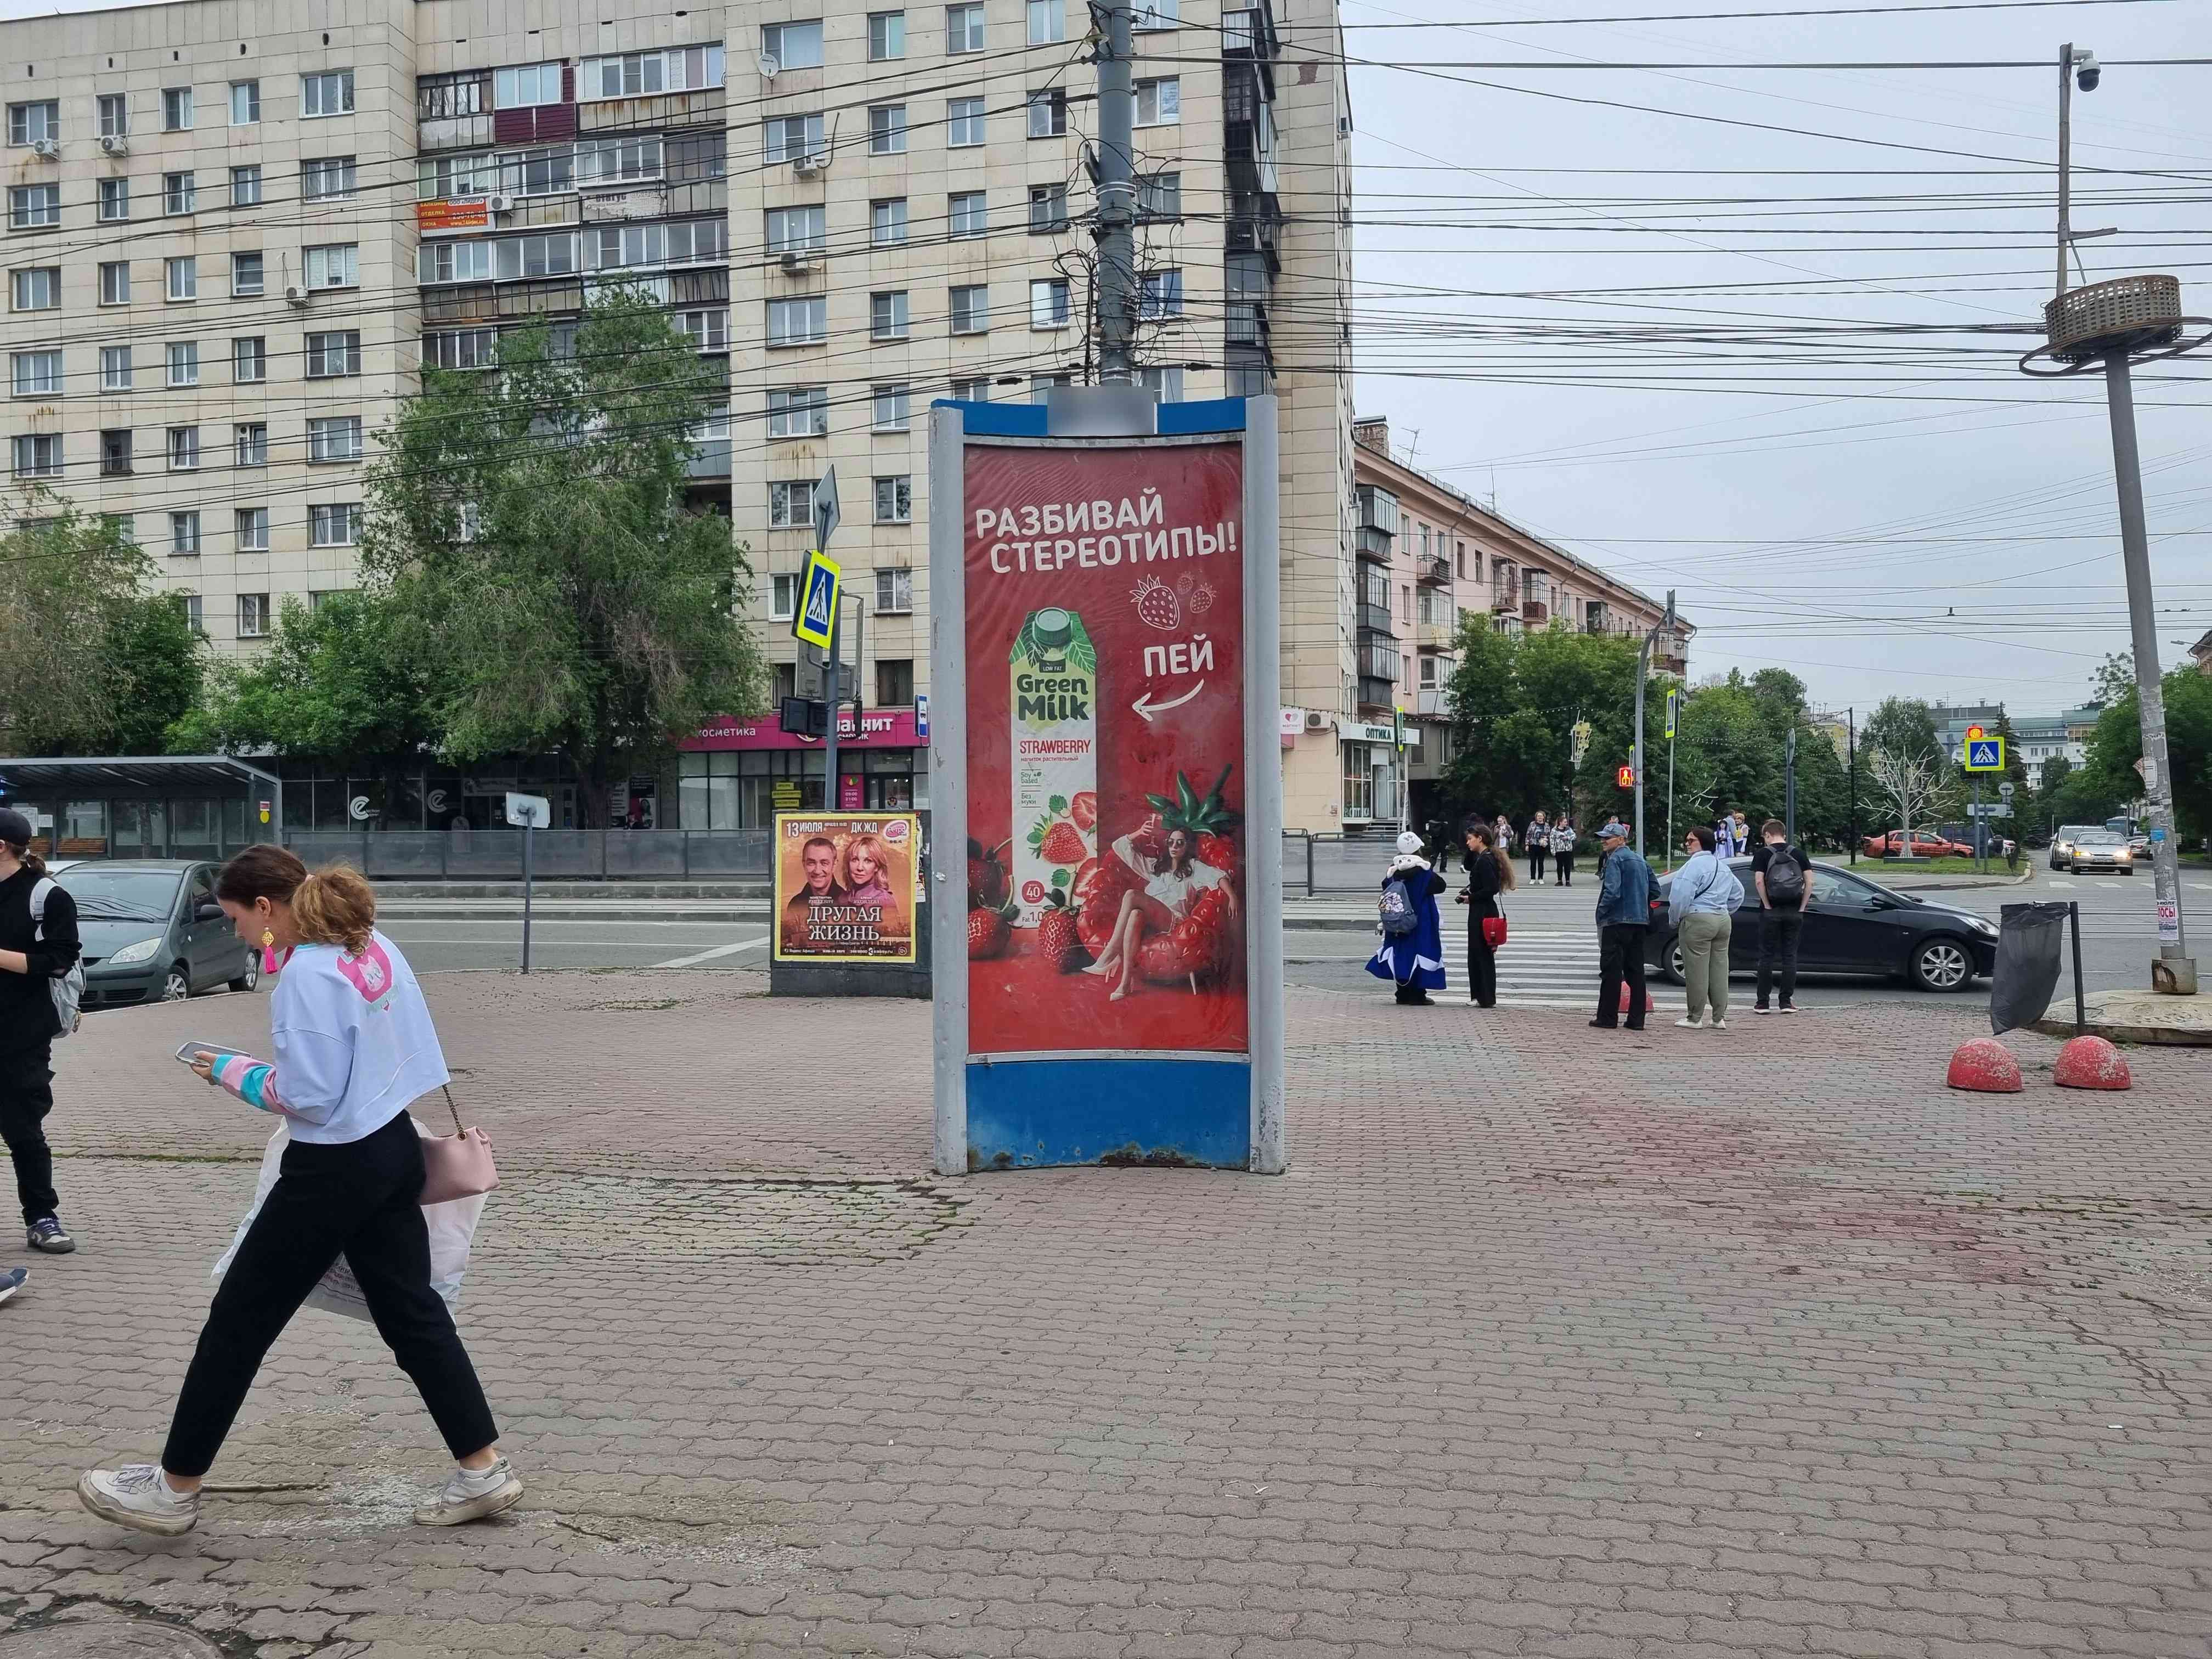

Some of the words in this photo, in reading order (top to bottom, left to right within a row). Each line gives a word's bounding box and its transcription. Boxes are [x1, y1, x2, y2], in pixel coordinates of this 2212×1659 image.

[975, 487, 1164, 539] РАЗБИВАЙ
[990, 521, 1237, 573] СТЕРЕОТИПЫ!
[1143, 633, 1214, 677] ПЕЙ
[1017, 674, 1088, 695] Green
[1018, 694, 1090, 721] Milk
[1365, 727, 1391, 740] ОПТИКА
[1020, 739, 1091, 754] STRAWBERRY
[786, 822, 799, 838] 13
[799, 822, 823, 833] ИЮЛЯ
[851, 822, 864, 834] ДК
[864, 822, 878, 834] ЖД
[1026, 886, 1041, 898] 40
[807, 906, 882, 924] ДРУГАЯ
[808, 925, 879, 940] ЖИЗНЬ
